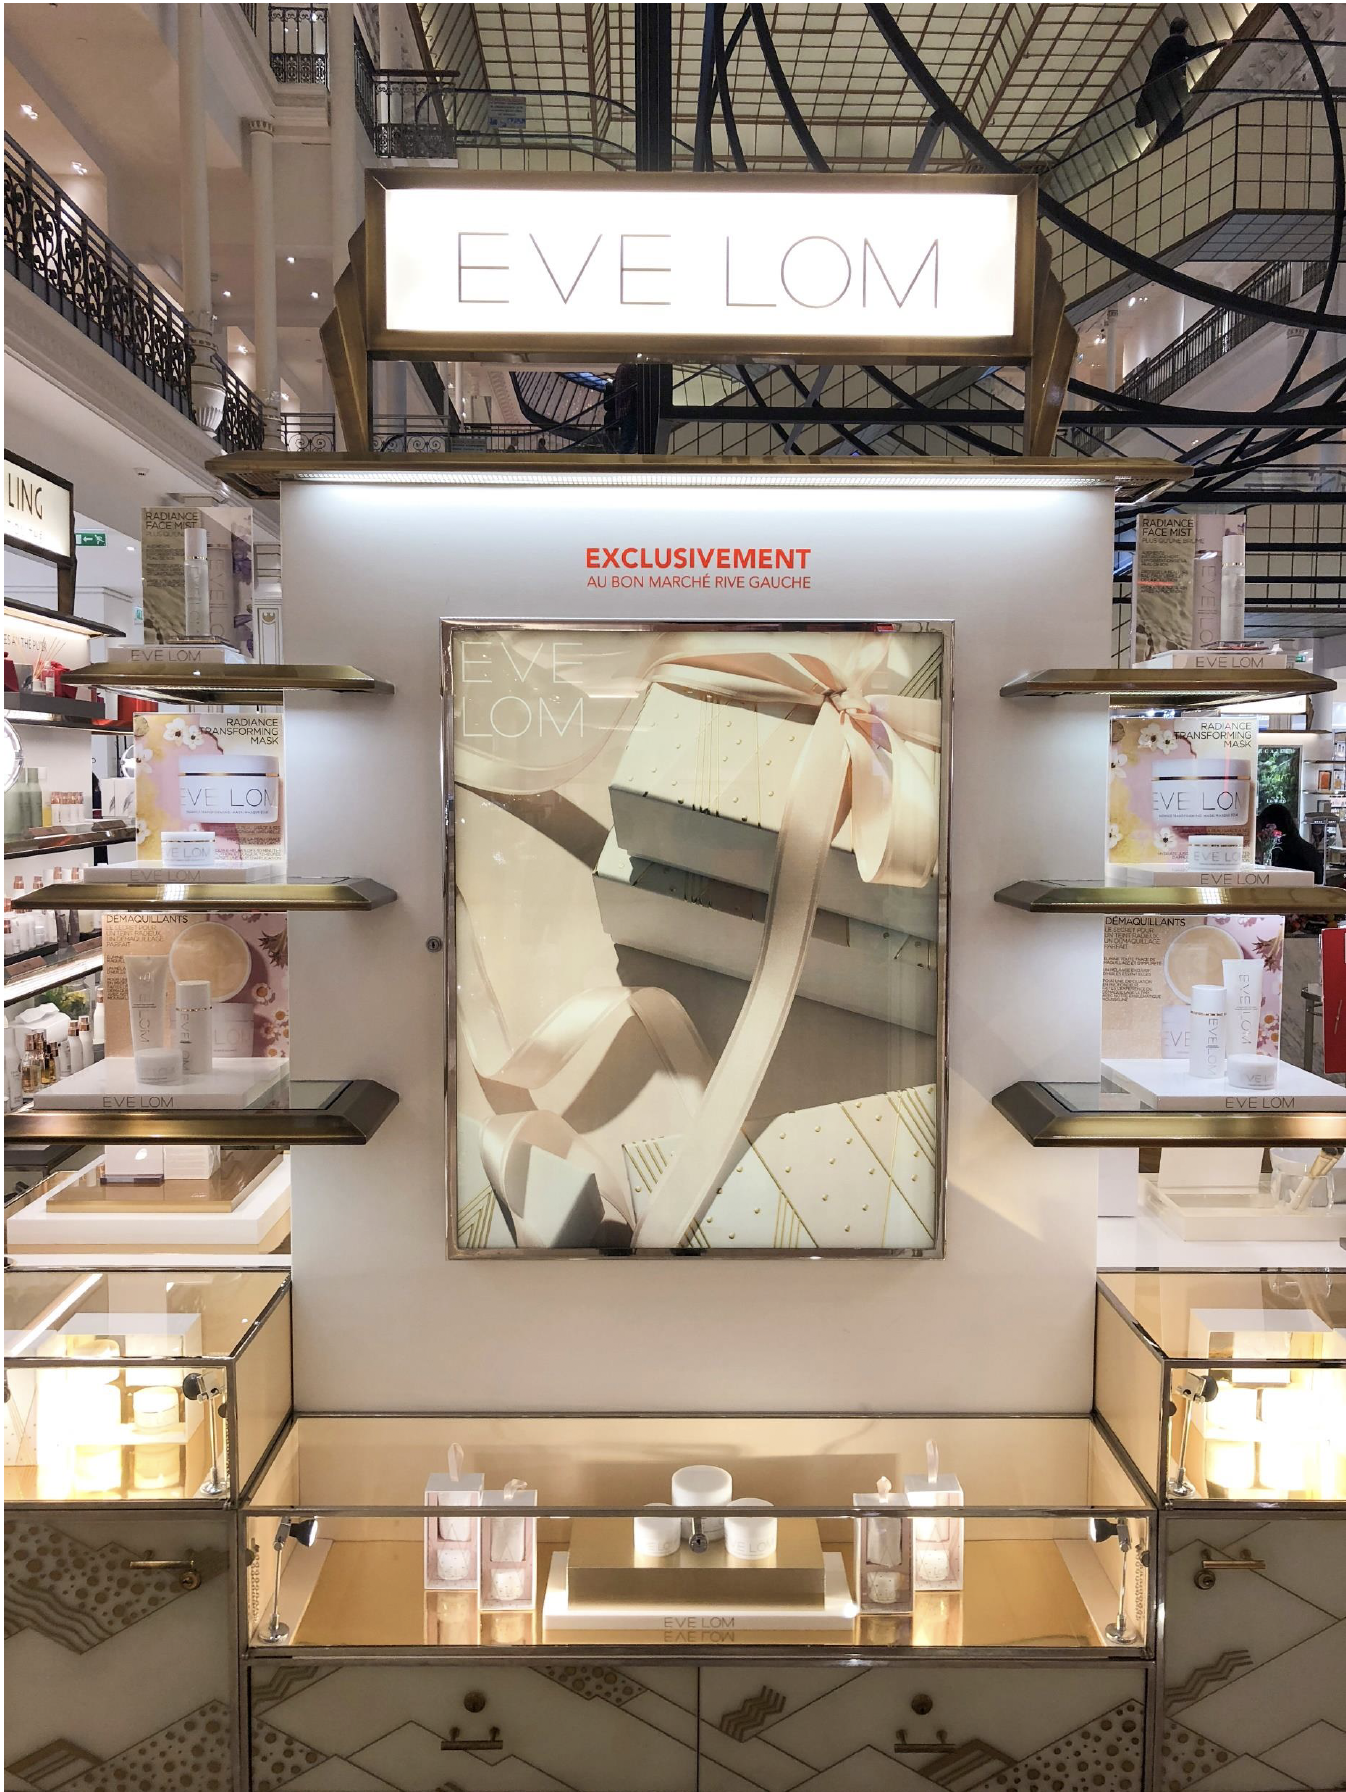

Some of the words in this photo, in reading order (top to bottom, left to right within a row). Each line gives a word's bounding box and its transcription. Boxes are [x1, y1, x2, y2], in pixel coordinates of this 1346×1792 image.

[457, 231, 672, 305] EVE
[726, 235, 939, 309] LOM
[145, 511, 199, 521] RADIANCE
[145, 521, 172, 530] FACE
[175, 521, 198, 529] MIST
[1142, 518, 1194, 528] RADIANCE
[1142, 527, 1167, 537] FACE
[1169, 527, 1193, 537] MIST
[586, 547, 812, 569] EXCLUSIVEMENT
[586, 575, 608, 588] AU
[611, 575, 644, 589] BON
[649, 573, 711, 589] MARCHÉ
[715, 576, 746, 589] RIVE
[749, 576, 812, 590] GAUCHE
[1201, 565, 1216, 607] EVE
[1199, 617, 1215, 644] LO
[131, 650, 163, 662] EVE
[168, 650, 201, 662] LOM
[461, 640, 584, 684] EVE
[1195, 656, 1228, 668] EVE
[1232, 656, 1264, 669] LOM
[226, 718, 279, 727] RADIANCE
[462, 695, 584, 739] LOM
[200, 727, 279, 736] TRANSFORMING
[1201, 722, 1252, 731] RADIANCE
[250, 736, 279, 745] MASK
[1174, 731, 1252, 740] TRANSFORMING
[1223, 740, 1252, 748] MASK
[180, 787, 219, 807] EVE
[1153, 791, 1190, 811] EVE
[130, 870, 162, 881] EVE
[167, 870, 201, 881] LOM
[1200, 873, 1234, 885] EVE
[1236, 873, 1270, 885] LOM
[1105, 916, 1186, 926] DÉMAQUILLANTS
[1238, 974, 1251, 1005] EVE
[1207, 1018, 1219, 1043] EVE
[102, 1096, 136, 1108] EVE
[140, 1096, 174, 1108] LOM
[1225, 1097, 1257, 1108] EVE
[1262, 1097, 1295, 1108] LOM
[664, 1617, 698, 1628] EVE
[701, 1617, 735, 1628] LOM
